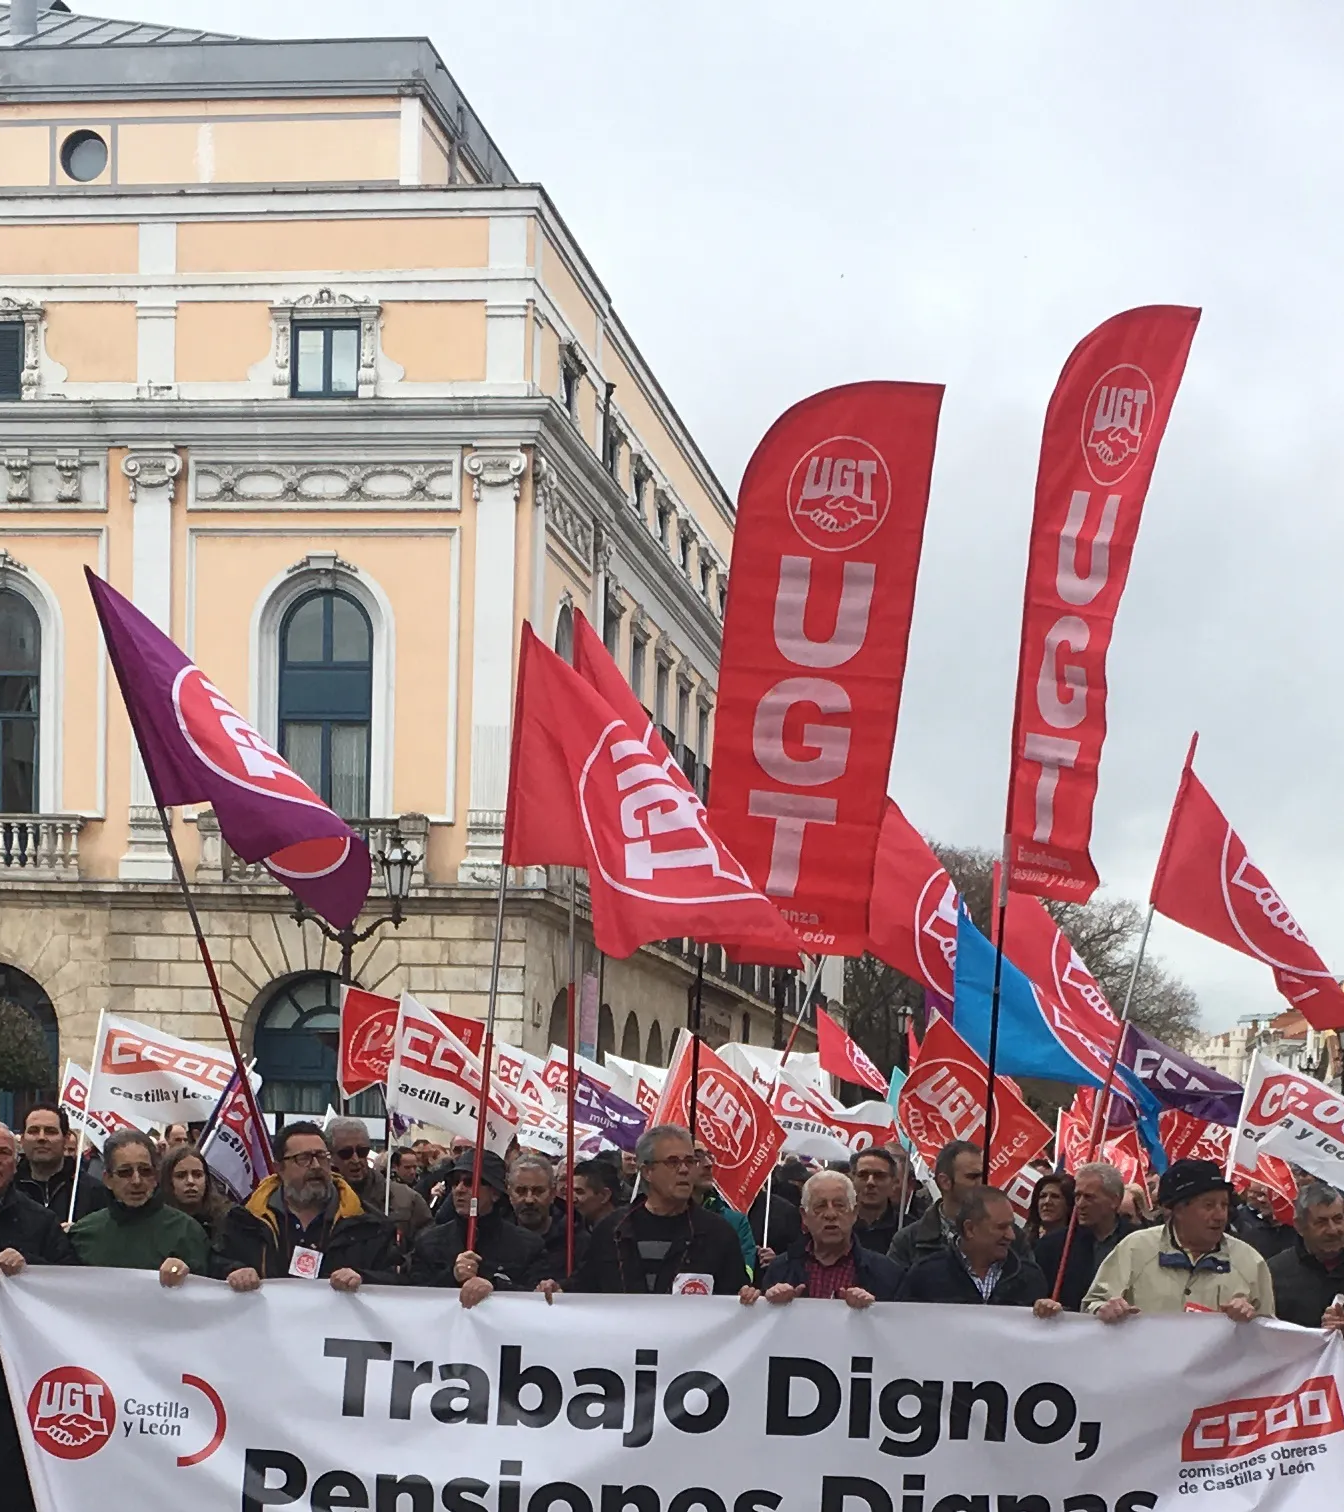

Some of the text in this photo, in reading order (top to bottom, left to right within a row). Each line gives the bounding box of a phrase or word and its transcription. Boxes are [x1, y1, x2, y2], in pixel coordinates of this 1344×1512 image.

[1094, 386, 1148, 433] UGT
[804, 456, 878, 503] UGT
[1023, 490, 1122, 845] UGT
[748, 555, 876, 897] UGT
[398, 1081, 450, 1109] astilla
[453, 1101, 465, 1115] y
[696, 1075, 752, 1143] UGT
[38, 1382, 105, 1419] UGT
[123, 1398, 189, 1419] Castilla
[323, 1337, 1102, 1463] Trabajo Digno,
[1193, 1388, 1332, 1449] CCOO
[123, 1418, 182, 1437] y León
[1179, 1443, 1328, 1479] comisiones obreras
[1179, 1460, 1315, 1495] de Castilla y León
